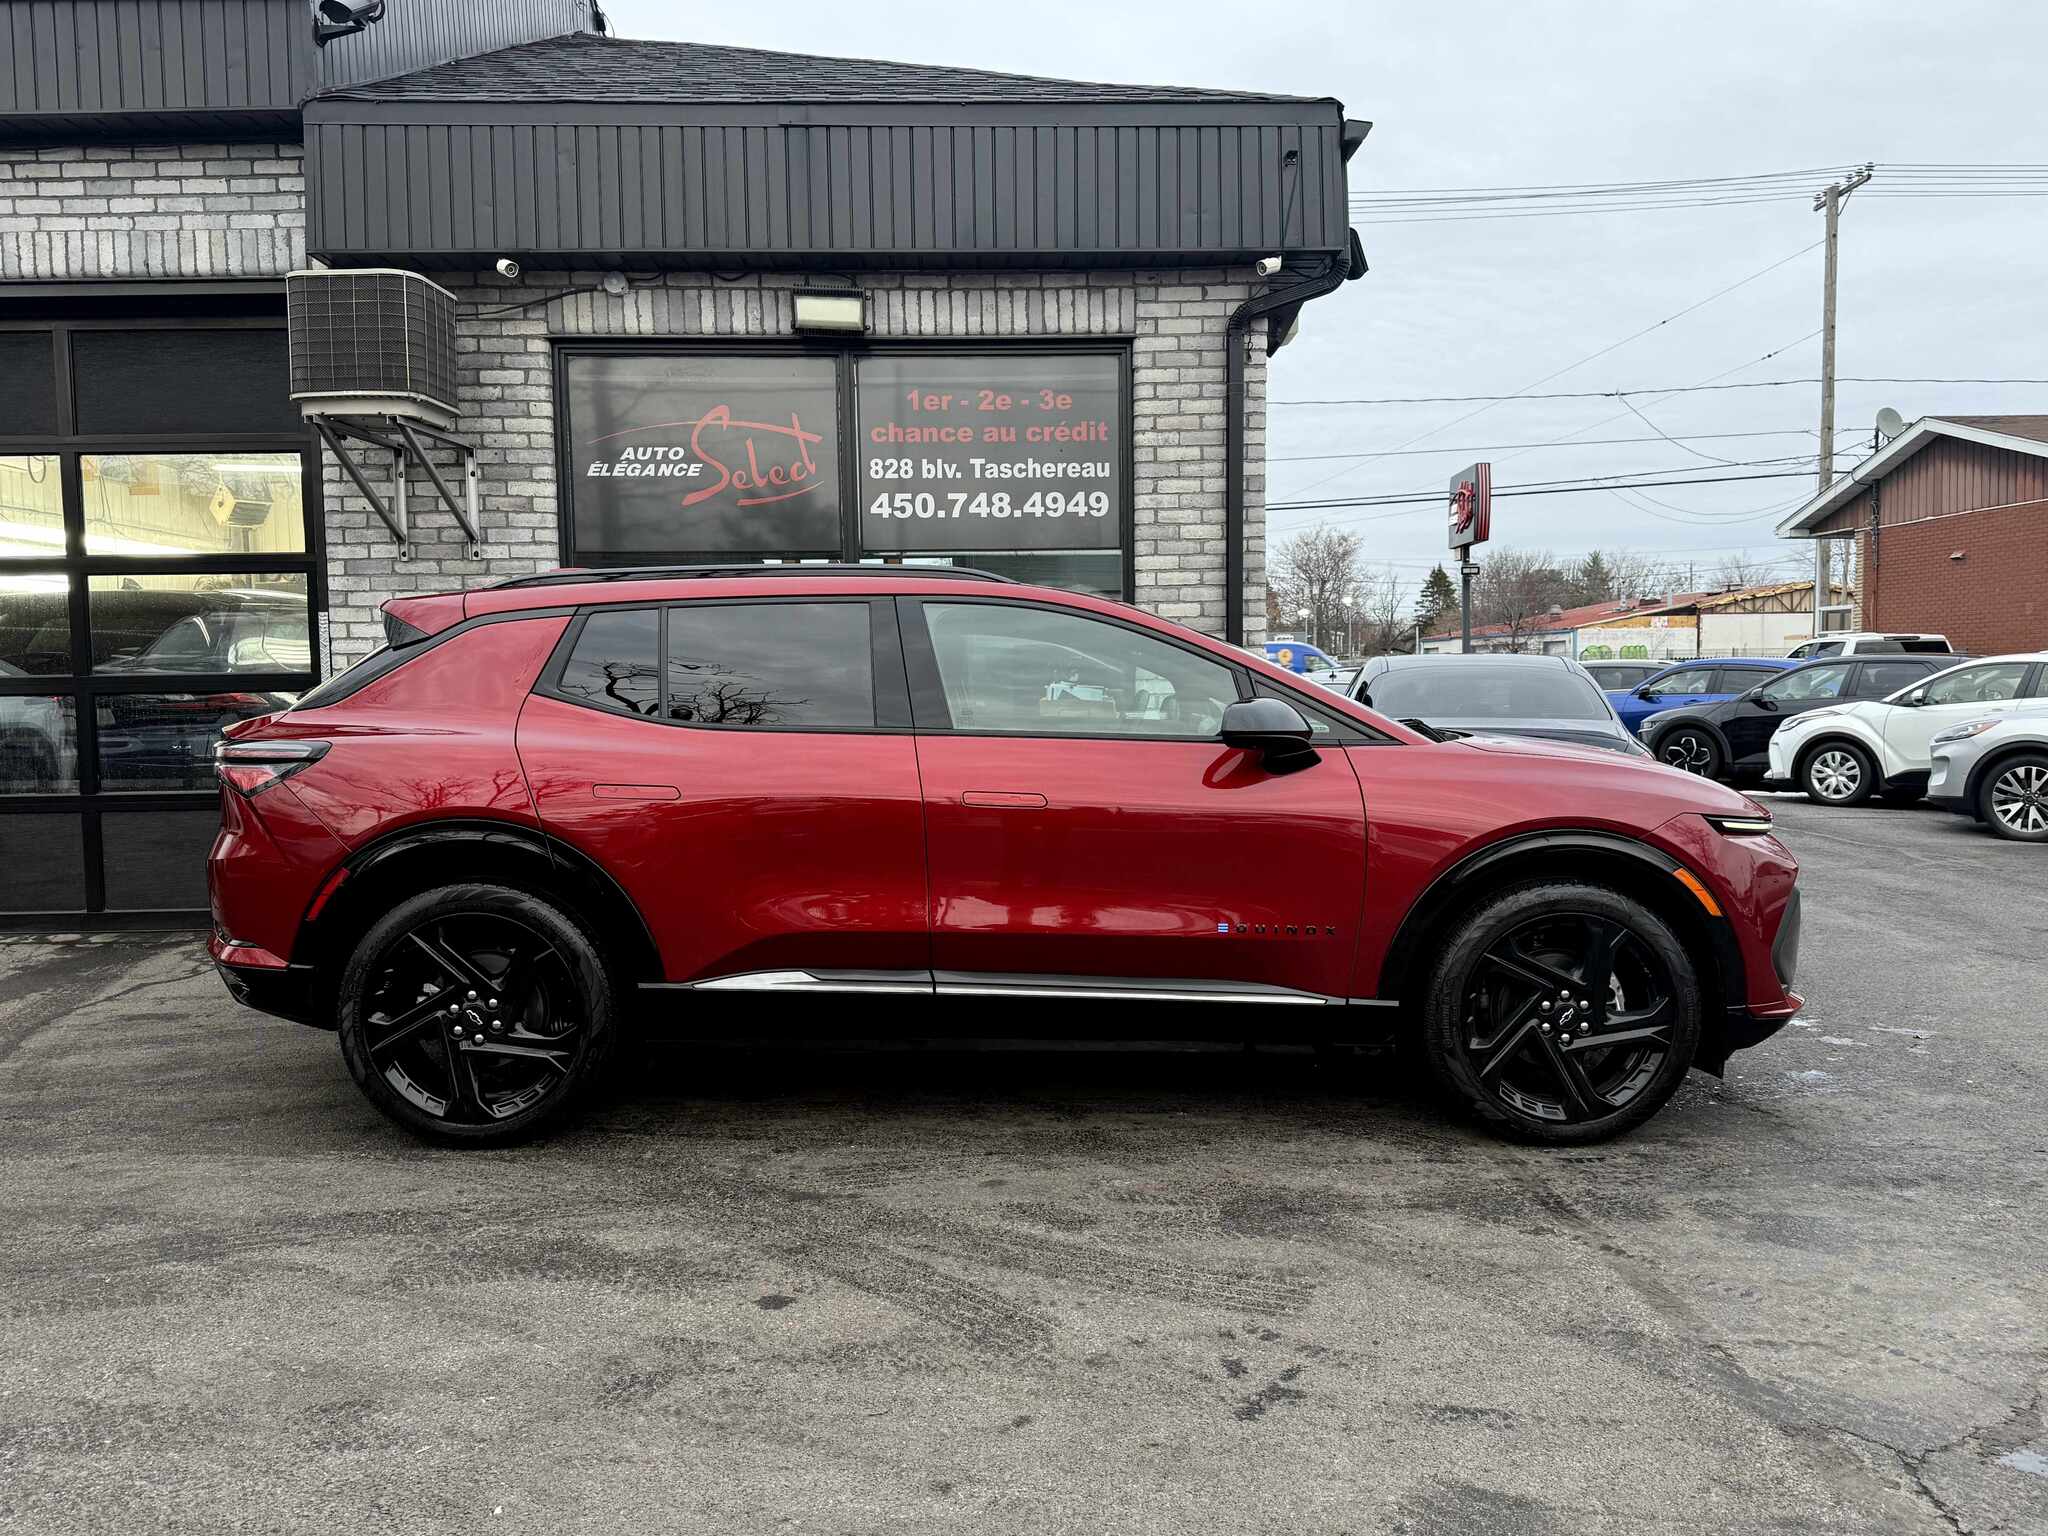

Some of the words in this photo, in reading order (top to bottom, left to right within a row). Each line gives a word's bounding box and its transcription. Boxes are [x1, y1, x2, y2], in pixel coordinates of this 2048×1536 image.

[907, 389, 953, 411] 1er
[978, 389, 1013, 411] 2e
[1039, 389, 1073, 411] 3e
[870, 422, 974, 443] chance
[983, 426, 1017, 443] au
[1026, 420, 1109, 442] crédit
[620, 447, 685, 461] AUTO
[681, 404, 824, 506] Select
[586, 460, 704, 477] ÉLÉGANCE
[869, 458, 914, 479] 828
[921, 458, 962, 479] blv.
[969, 457, 1110, 479] Taschereau
[869, 491, 1110, 519] 450.748.4949
